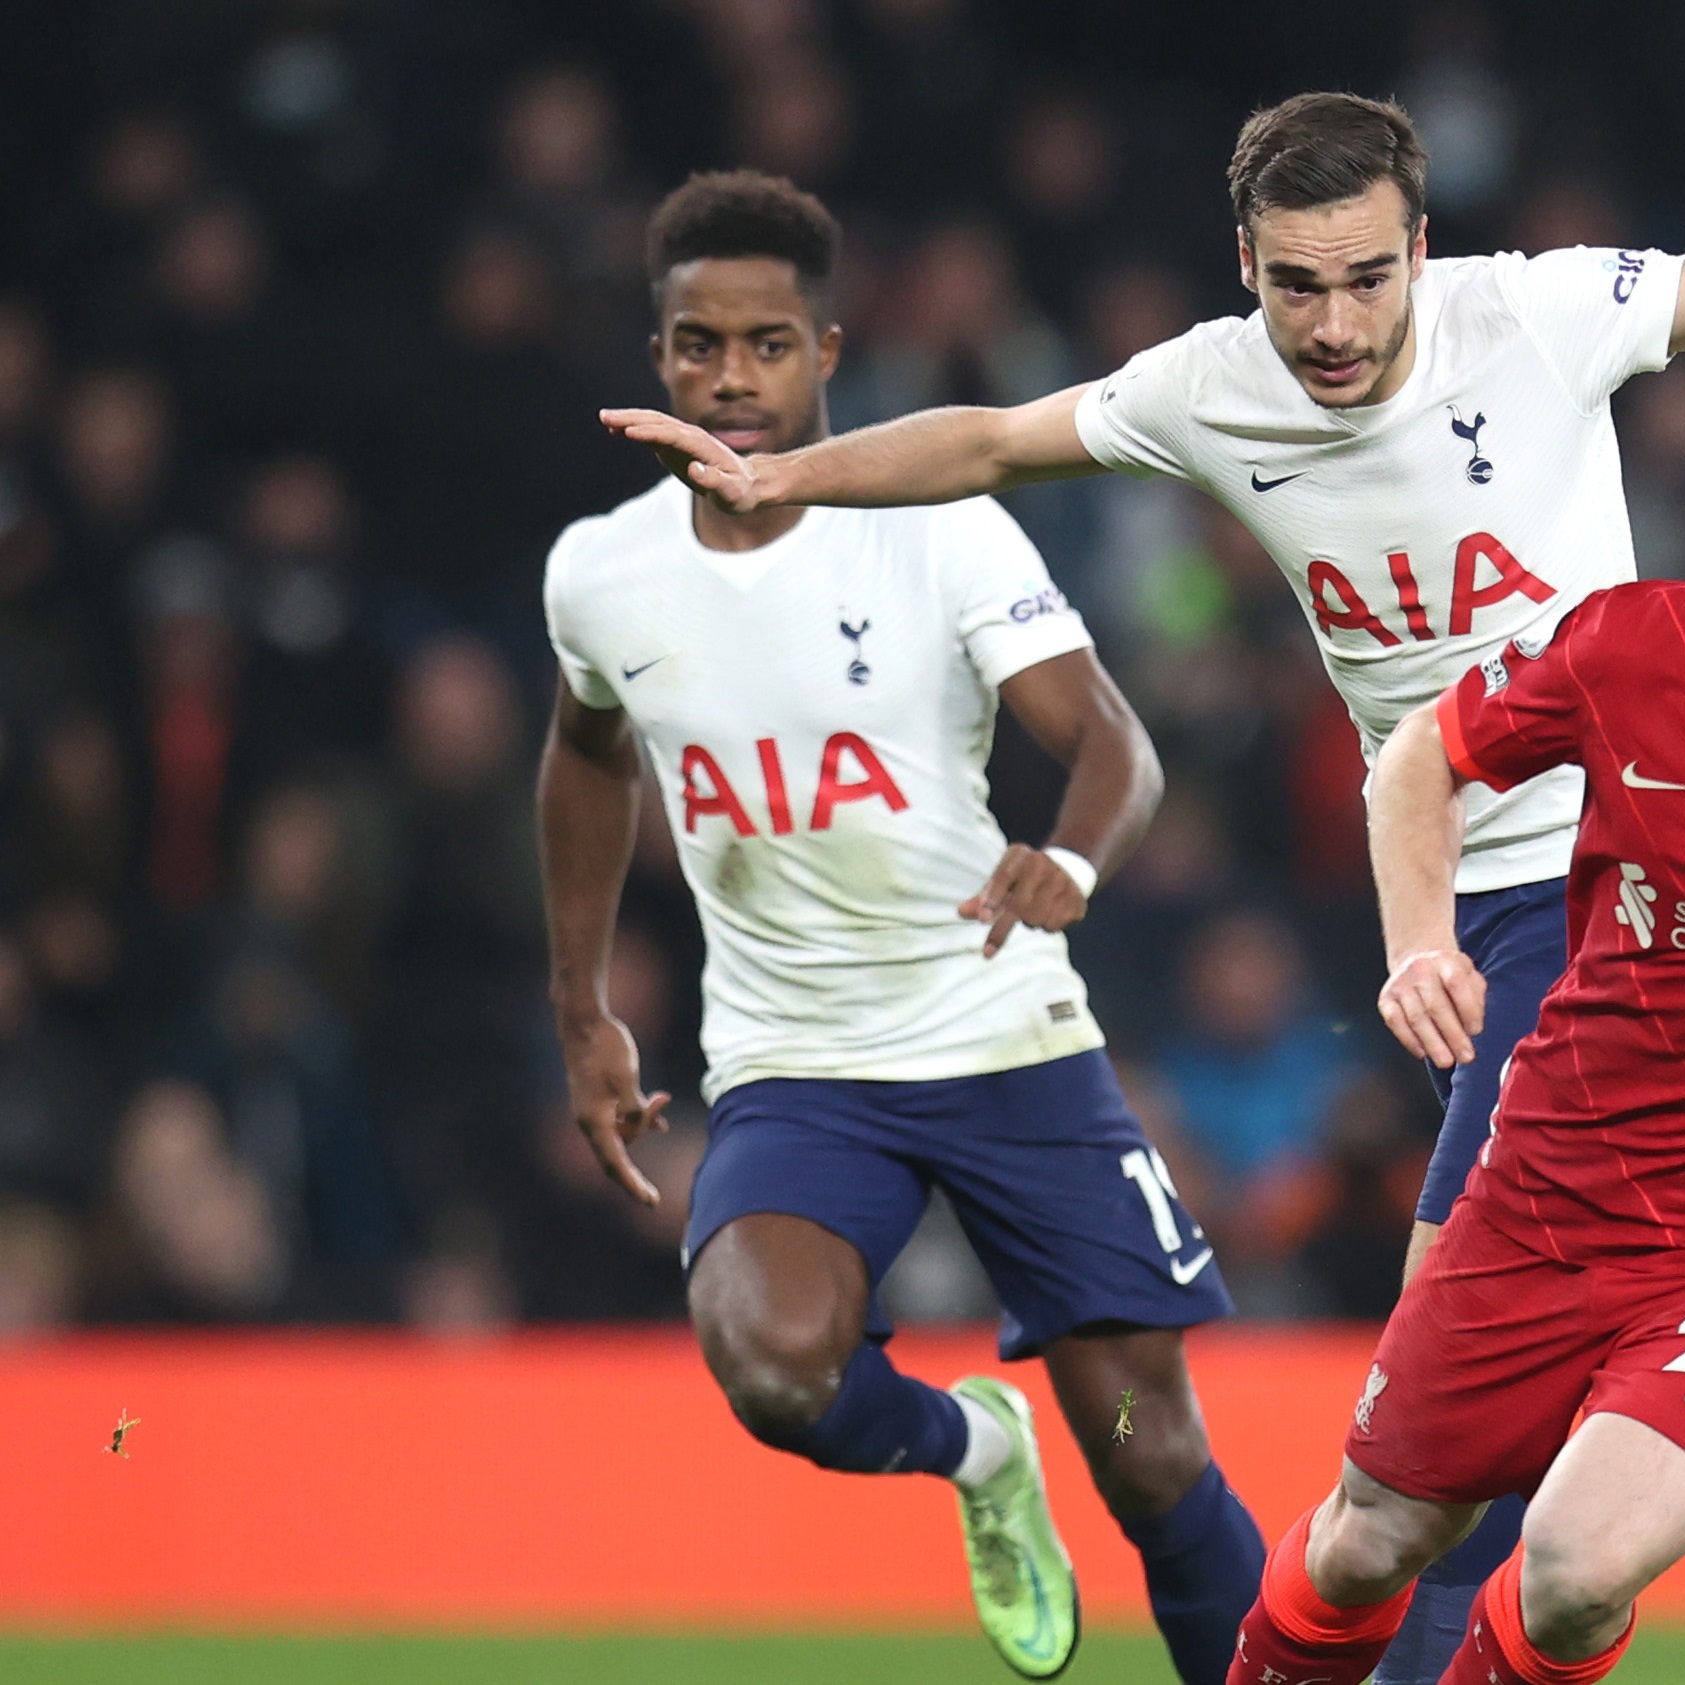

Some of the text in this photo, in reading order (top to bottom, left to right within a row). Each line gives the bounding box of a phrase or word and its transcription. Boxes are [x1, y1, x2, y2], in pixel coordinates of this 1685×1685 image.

[1612, 249, 1645, 304] cin
[1308, 532, 1557, 646] AIA
[681, 732, 908, 837] AIA
